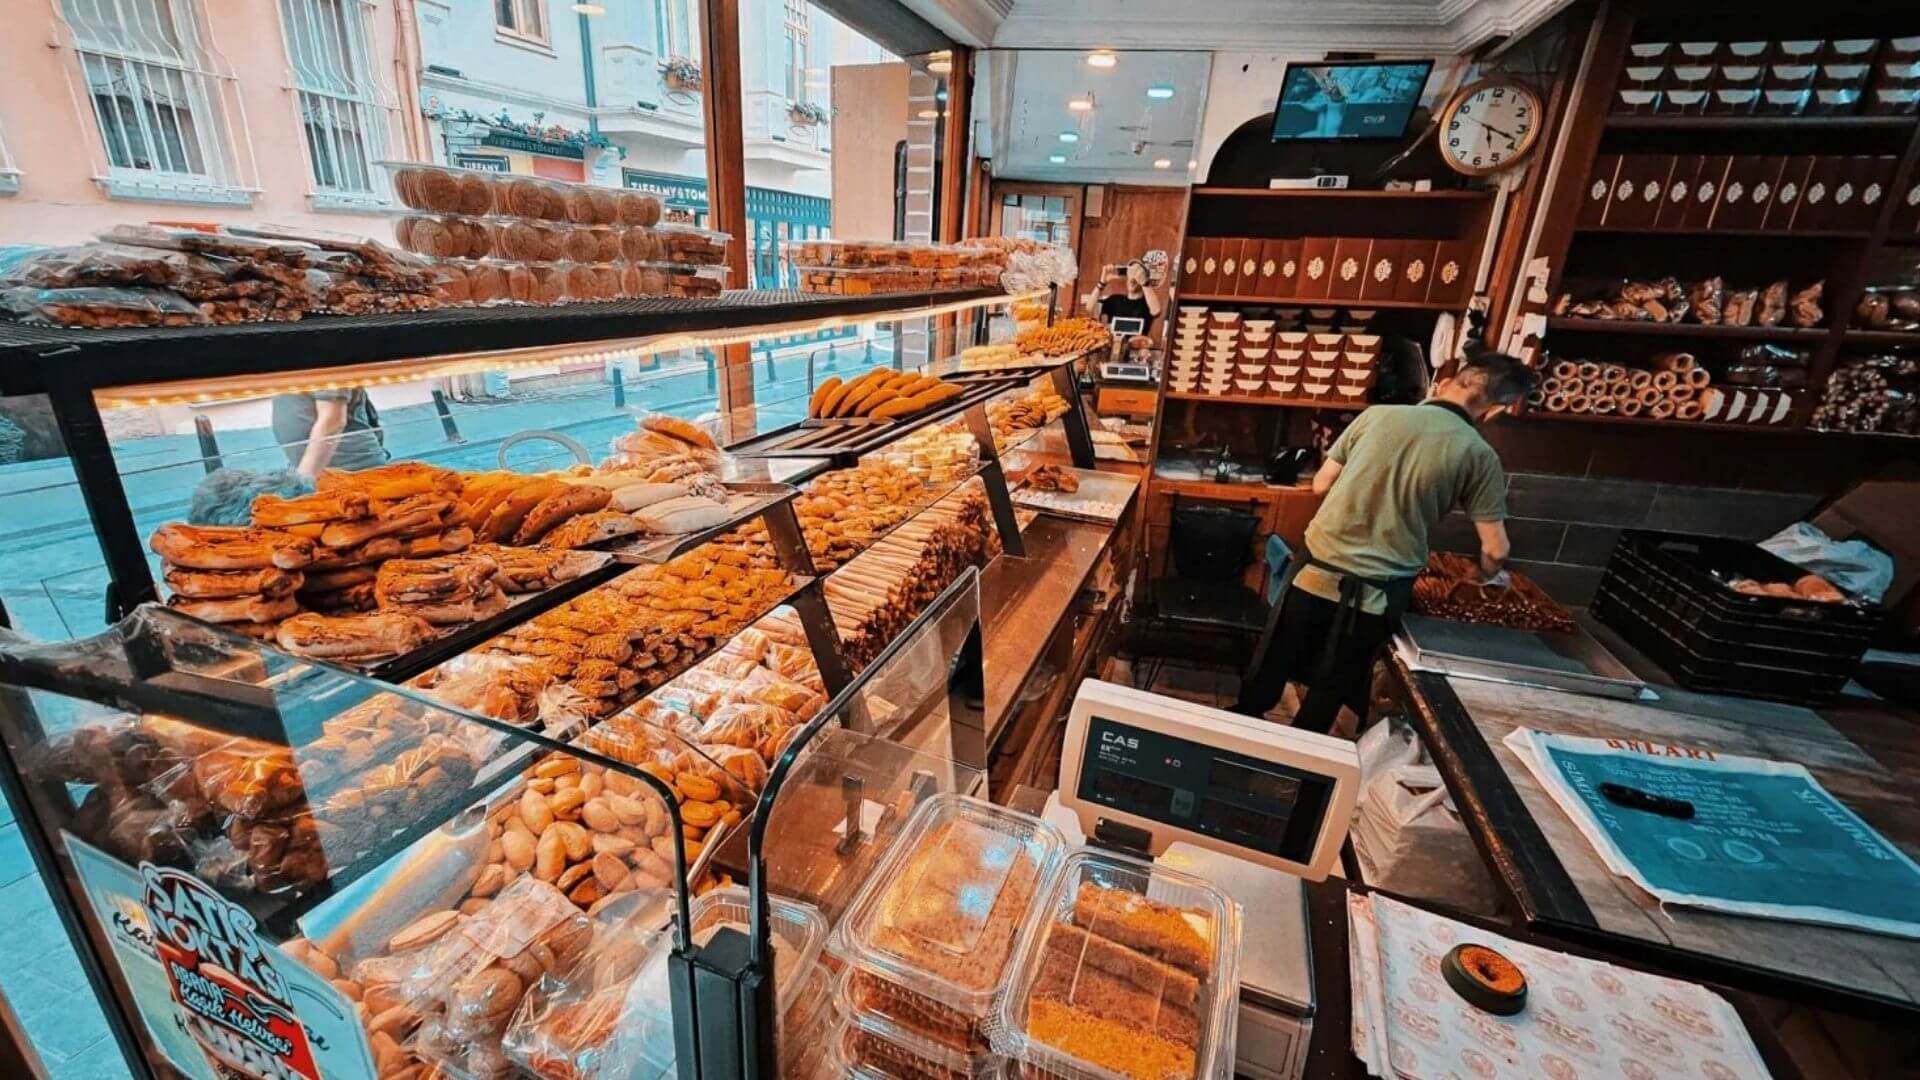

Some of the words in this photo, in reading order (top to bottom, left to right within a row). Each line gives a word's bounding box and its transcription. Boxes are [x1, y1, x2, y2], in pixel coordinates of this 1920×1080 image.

[1476, 93, 1485, 102] 11
[1492, 88, 1504, 98] 12
[1511, 95, 1516, 104] 1
[1460, 104, 1470, 114] 10
[1516, 108, 1526, 118] 2
[1450, 121, 1460, 130] 9
[1516, 124, 1526, 134] 3
[1450, 138, 1459, 147] 8
[1506, 142, 1515, 150] 4
[1460, 151, 1467, 160] 7
[1490, 152, 1500, 161] 5
[1473, 156, 1482, 166] 6
[1102, 731, 1139, 750] CAS
[142, 866, 260, 960] SATIŞ
[144, 904, 293, 1009] NOKTASI
